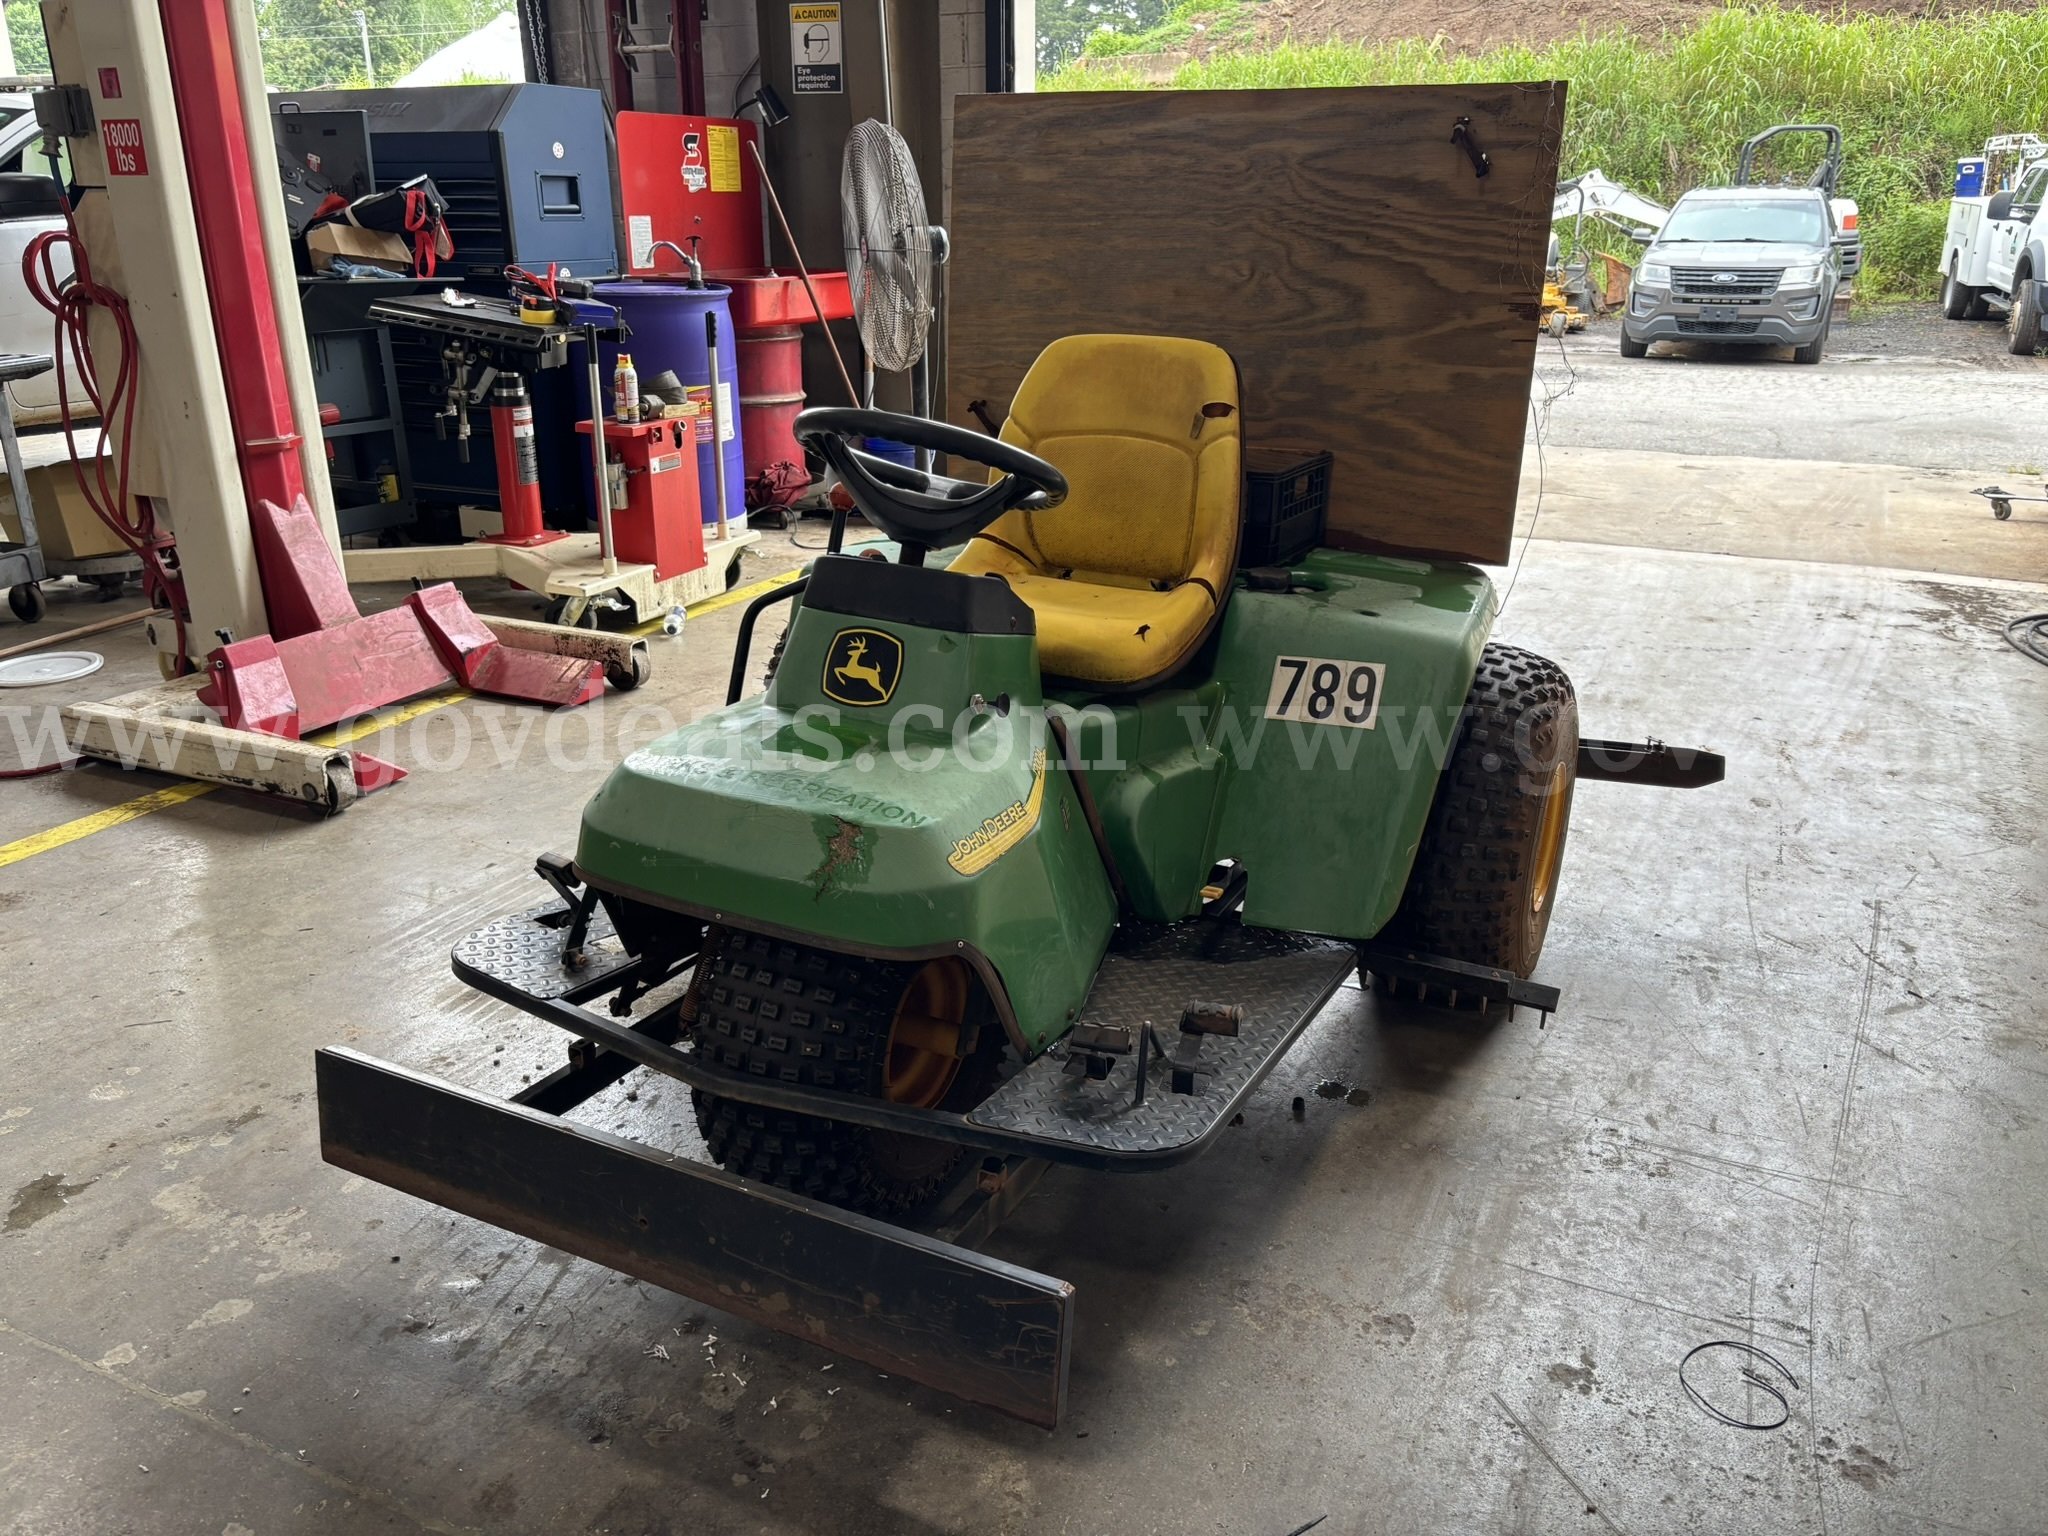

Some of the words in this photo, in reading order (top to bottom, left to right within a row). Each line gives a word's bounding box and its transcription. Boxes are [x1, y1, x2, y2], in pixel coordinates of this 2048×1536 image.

[801, 9, 837, 20] CAUTION
[797, 66, 811, 76] Eye
[797, 73, 836, 83] protection
[797, 81, 831, 91] required.
[103, 122, 140, 148] 18000
[115, 147, 137, 172] lbs
[1275, 658, 1378, 725] 789
[741, 769, 929, 829] RECREATION
[950, 826, 989, 861] JOHN
[983, 800, 1028, 839] DEERE
